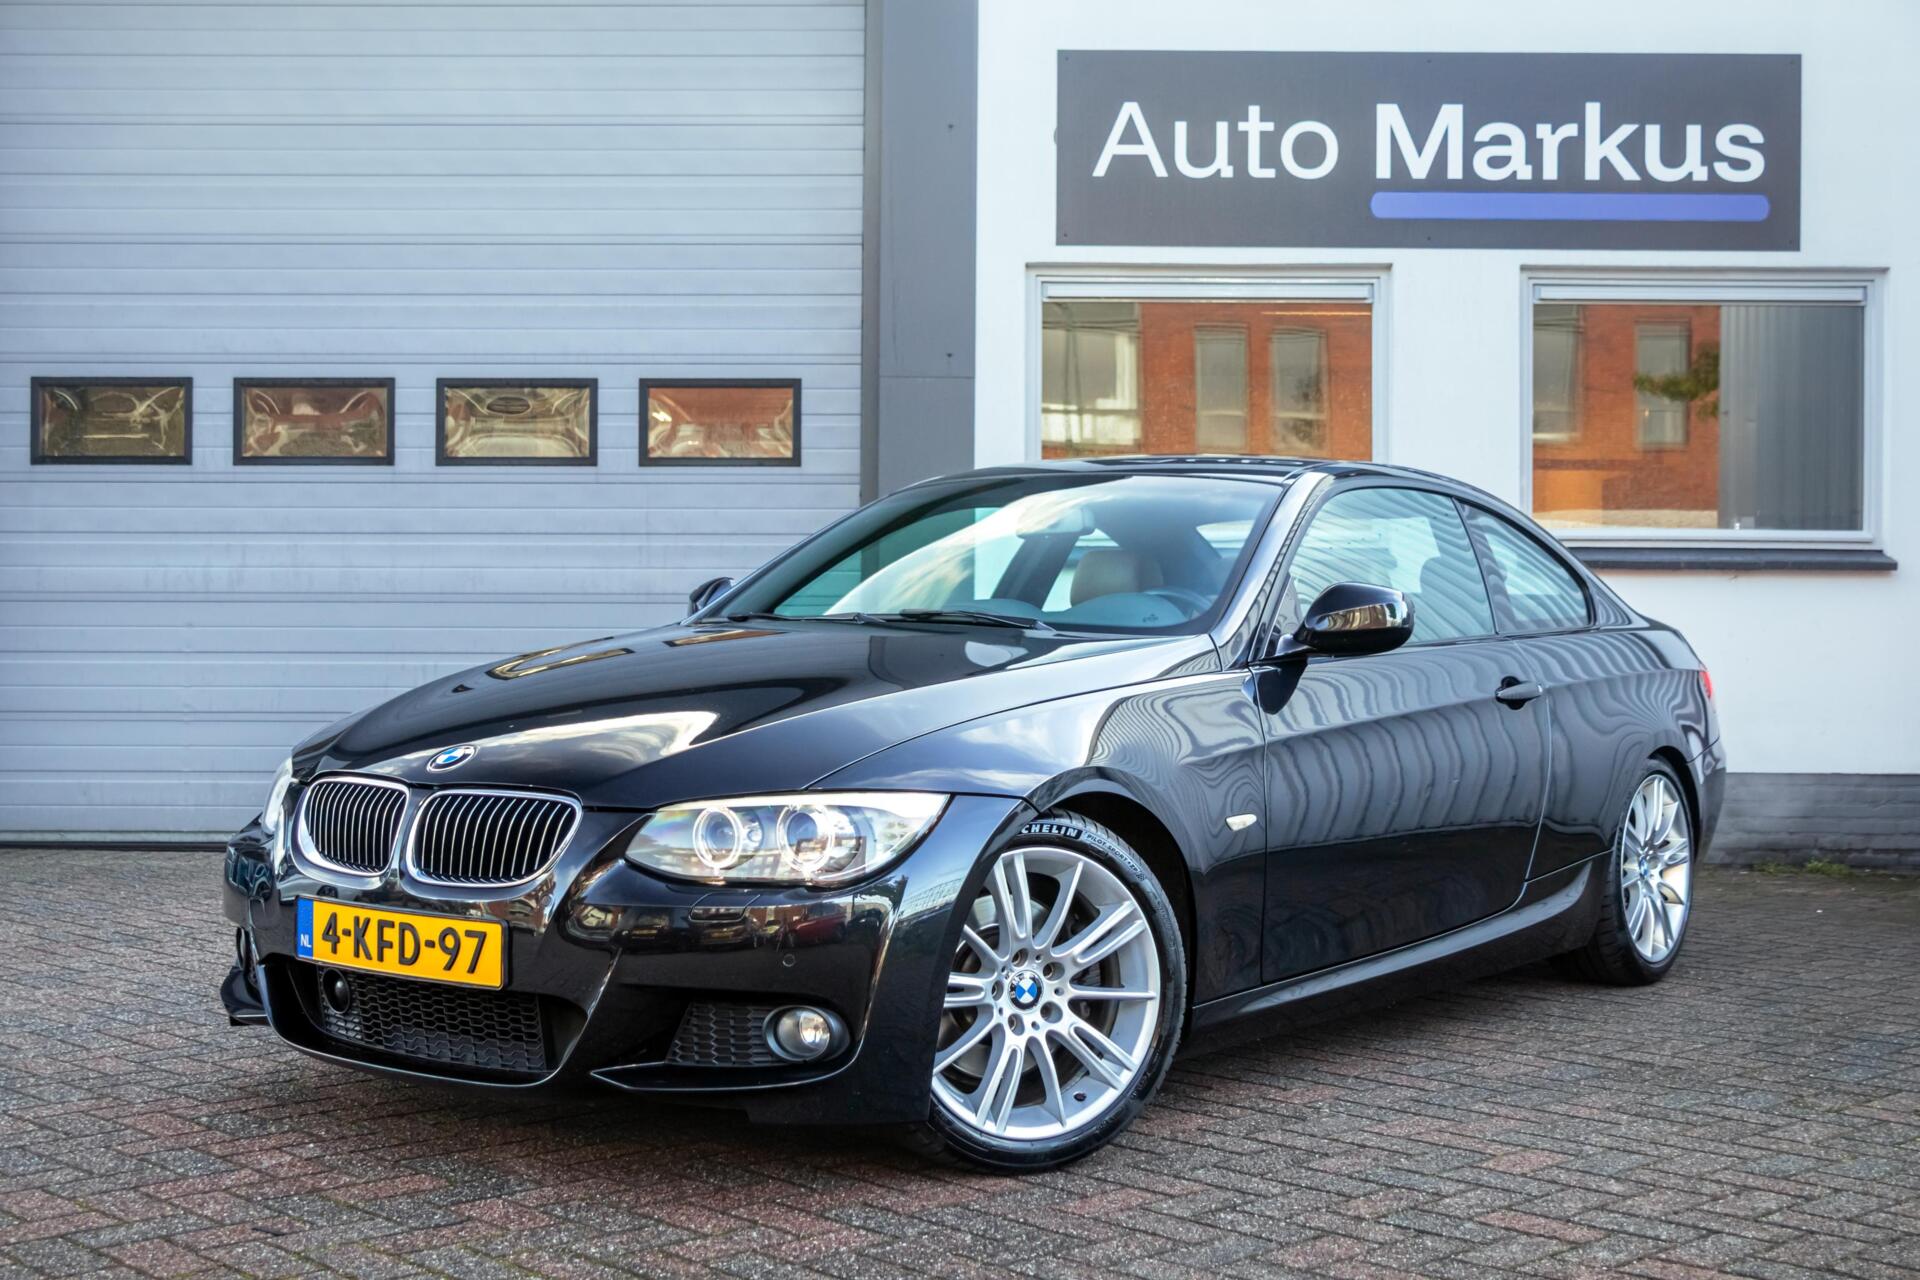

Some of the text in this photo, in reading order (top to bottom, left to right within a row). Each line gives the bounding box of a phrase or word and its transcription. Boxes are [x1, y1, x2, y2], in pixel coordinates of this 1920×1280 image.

[1092, 101, 1766, 183] Auto Markus
[1087, 834, 1106, 846] PILOT
[1107, 844, 1128, 863] SPORT
[300, 934, 312, 948] NL
[322, 912, 487, 974] 4-KFD-97
